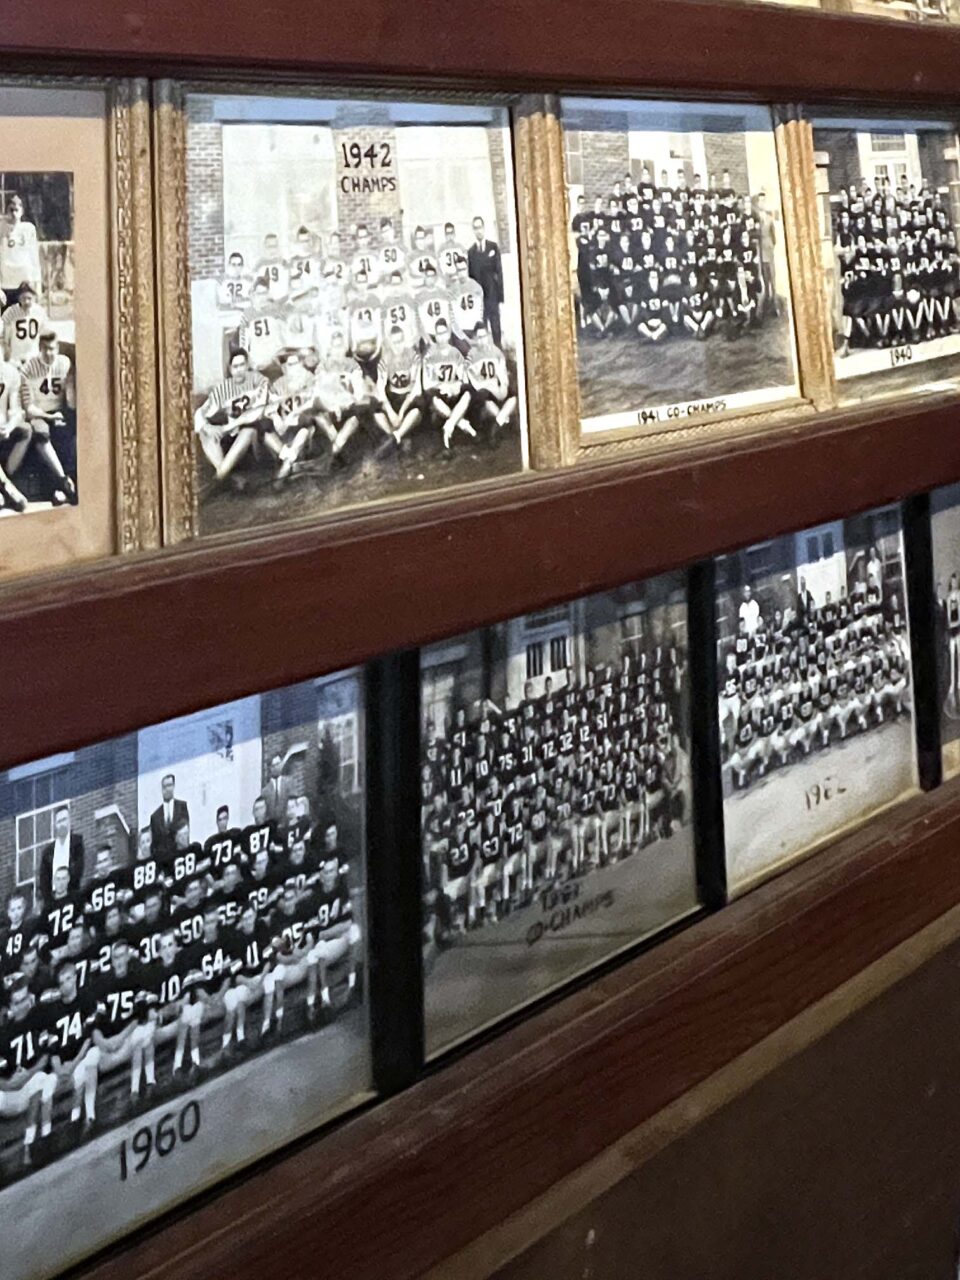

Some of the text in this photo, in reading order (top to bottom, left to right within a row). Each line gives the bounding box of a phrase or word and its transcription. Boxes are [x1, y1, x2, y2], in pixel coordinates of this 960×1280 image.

[341, 142, 392, 169] 1942
[341, 176, 396, 194] CHAMPS
[15, 319, 39, 340] 50
[254, 318, 270, 337] 51
[40, 378, 62, 396] 45
[212, 839, 233, 867] 73
[249, 826, 270, 854] 87
[174, 852, 196, 880] 68
[91, 882, 116, 912] 66
[48, 904, 74, 937] 72
[180, 915, 203, 944] 50
[6, 933, 23, 956] 49
[160, 974, 180, 1003] 10
[107, 990, 135, 1022] 75
[56, 1011, 83, 1047] 74
[10, 1031, 35, 1068] 71
[120, 1101, 200, 1181] 1960
